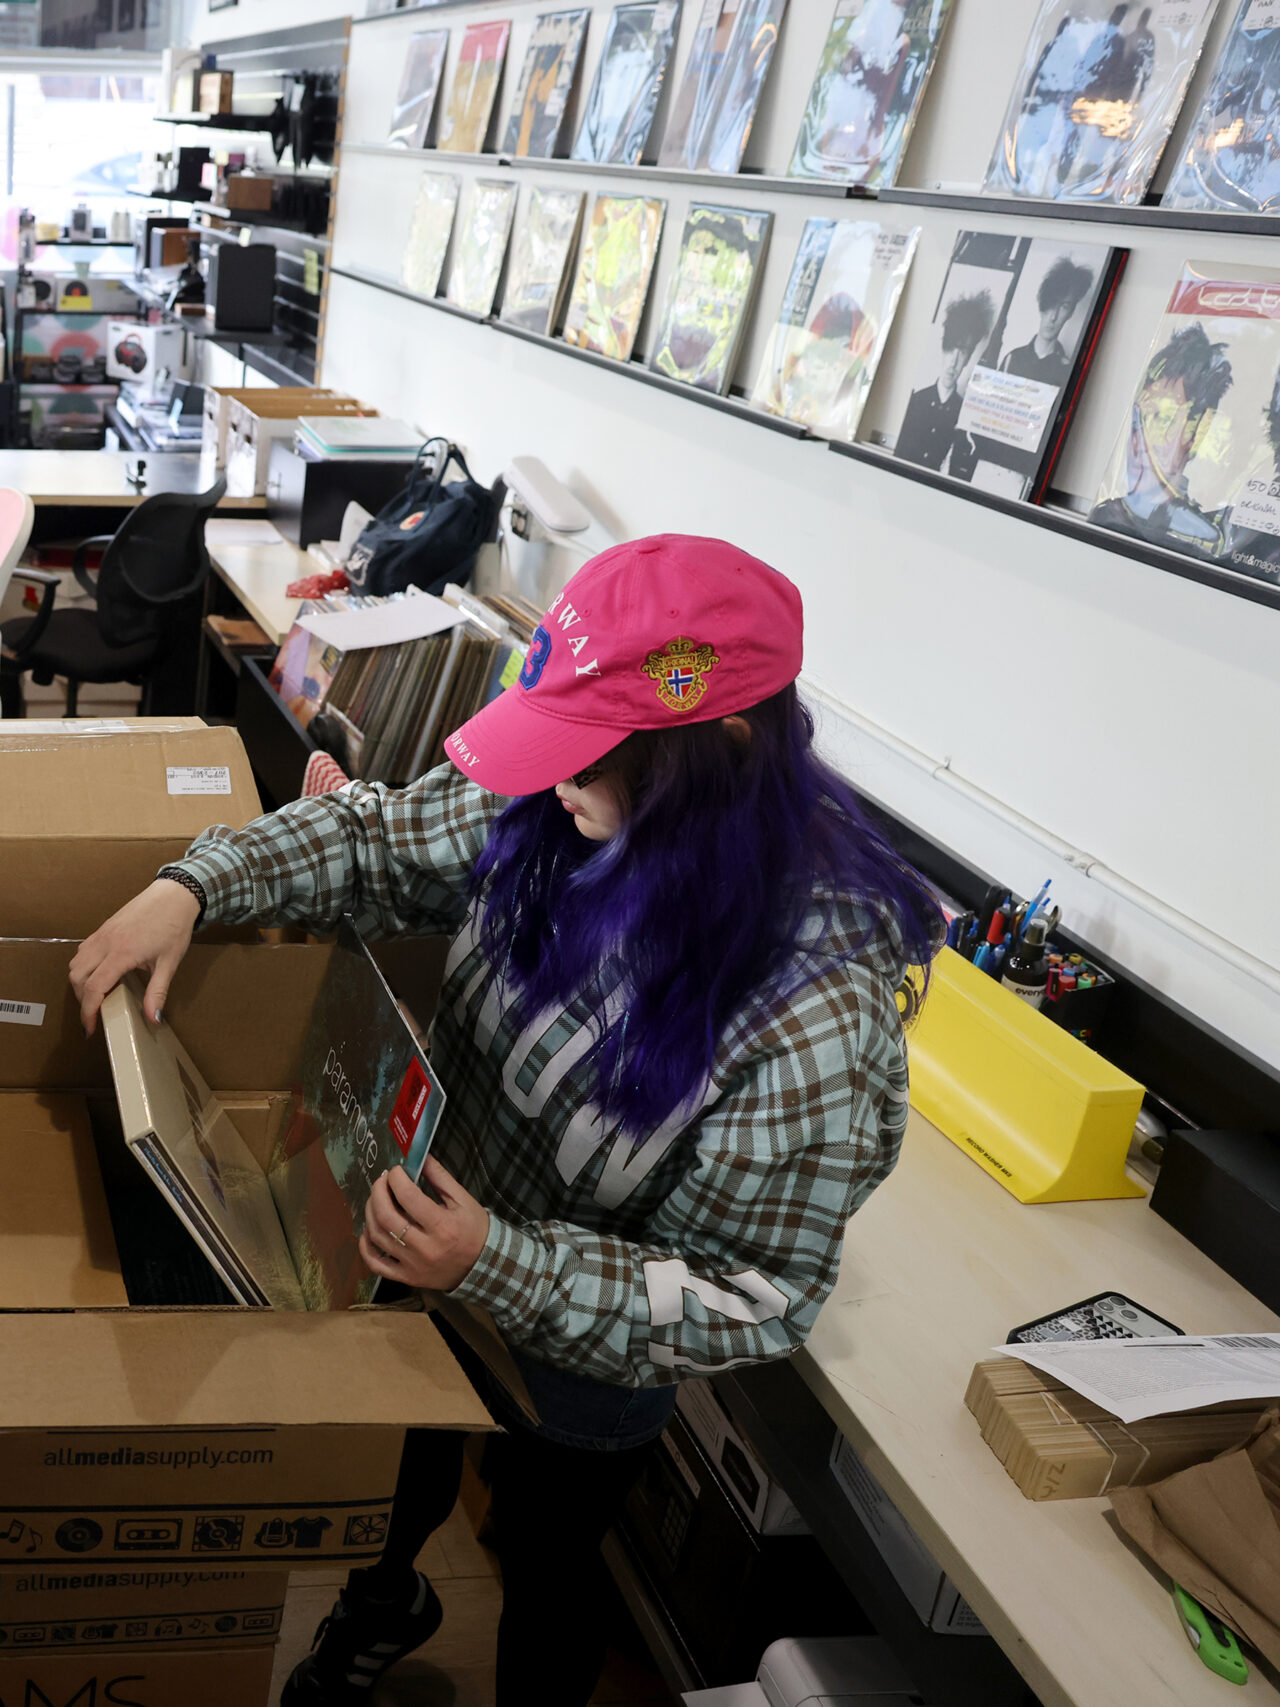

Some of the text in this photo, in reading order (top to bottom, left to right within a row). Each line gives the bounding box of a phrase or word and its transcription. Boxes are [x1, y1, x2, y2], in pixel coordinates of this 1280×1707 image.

[322, 1047, 378, 1169] paramore
[966, 1137, 984, 1155] RECORD
[43, 1446, 275, 1470] allmediasupply.com
